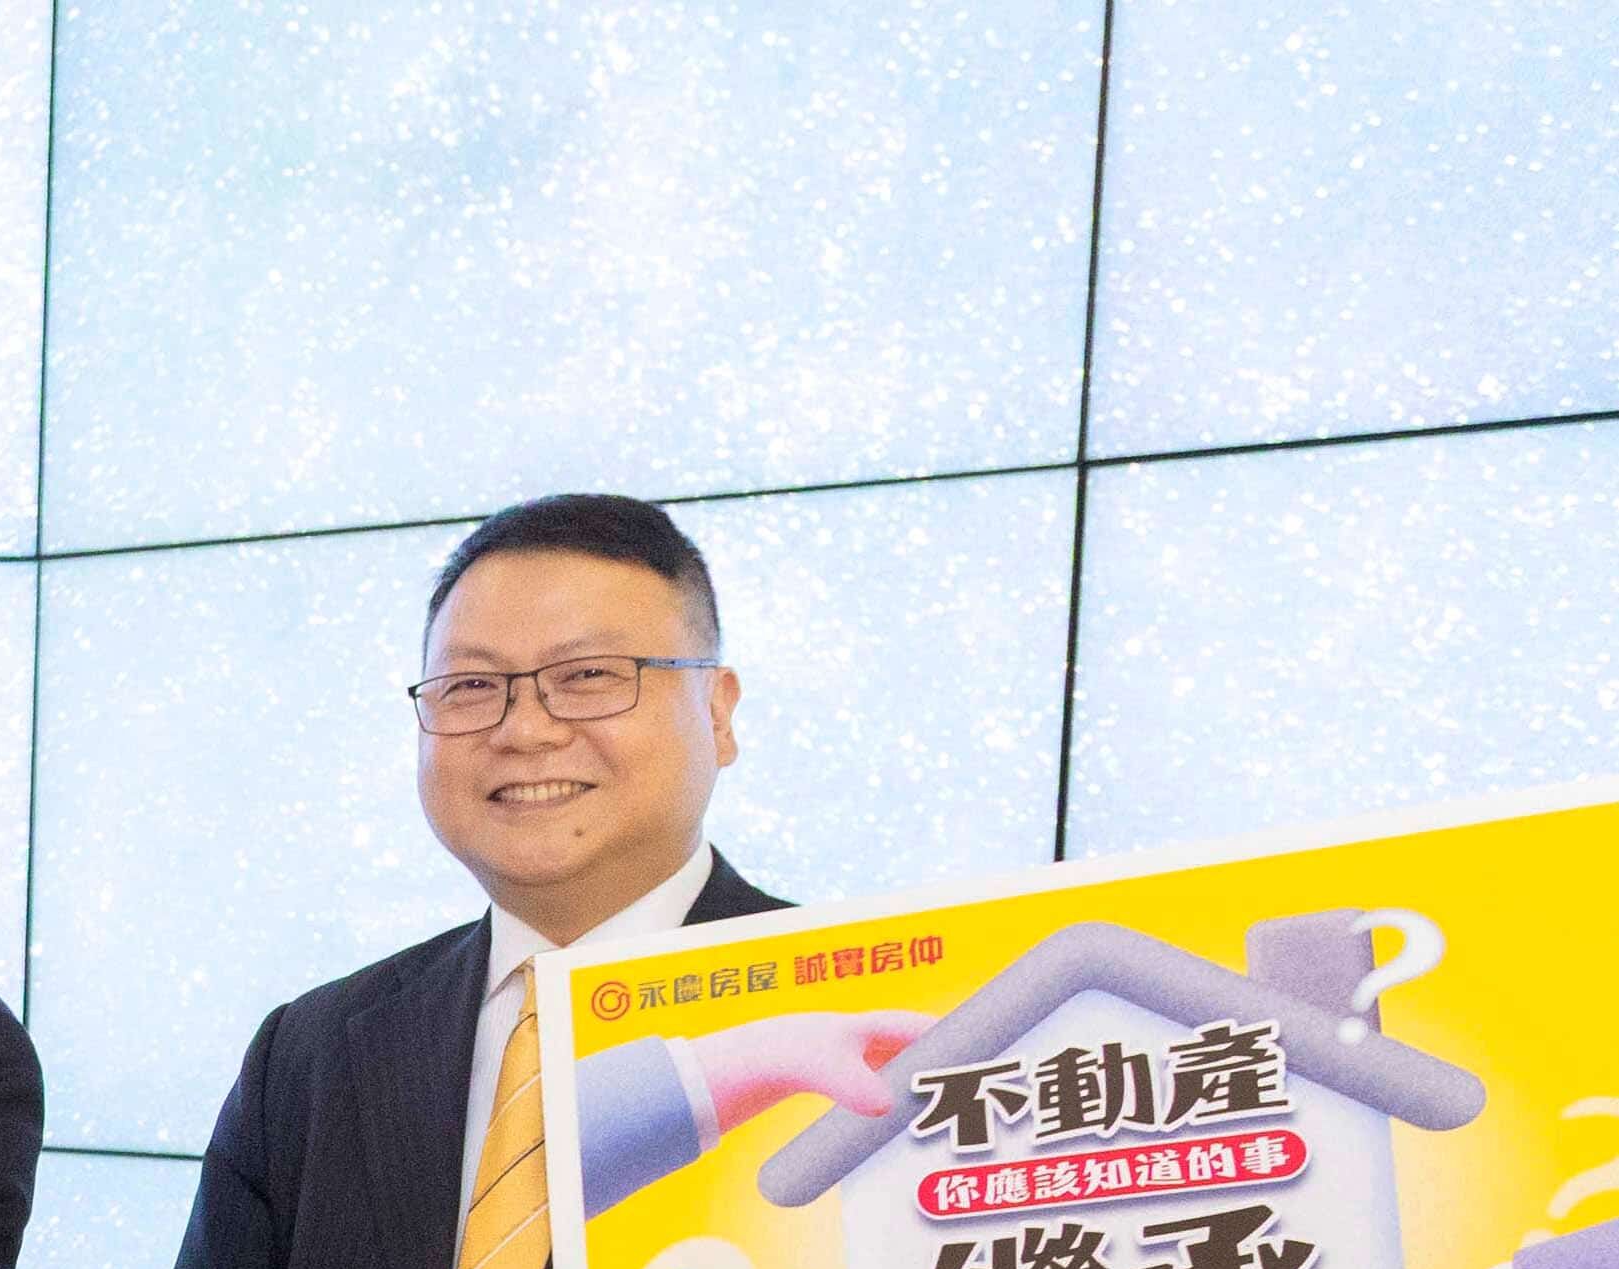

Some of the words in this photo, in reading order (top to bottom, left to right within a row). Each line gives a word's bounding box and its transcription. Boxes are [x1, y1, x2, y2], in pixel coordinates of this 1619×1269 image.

[638, 961, 779, 1010] 永慶房屋
[794, 935, 944, 986] 誠實房仲
[911, 1020, 1290, 1150] 不動產
[932, 1136, 1292, 1211] 你應該知道的事
